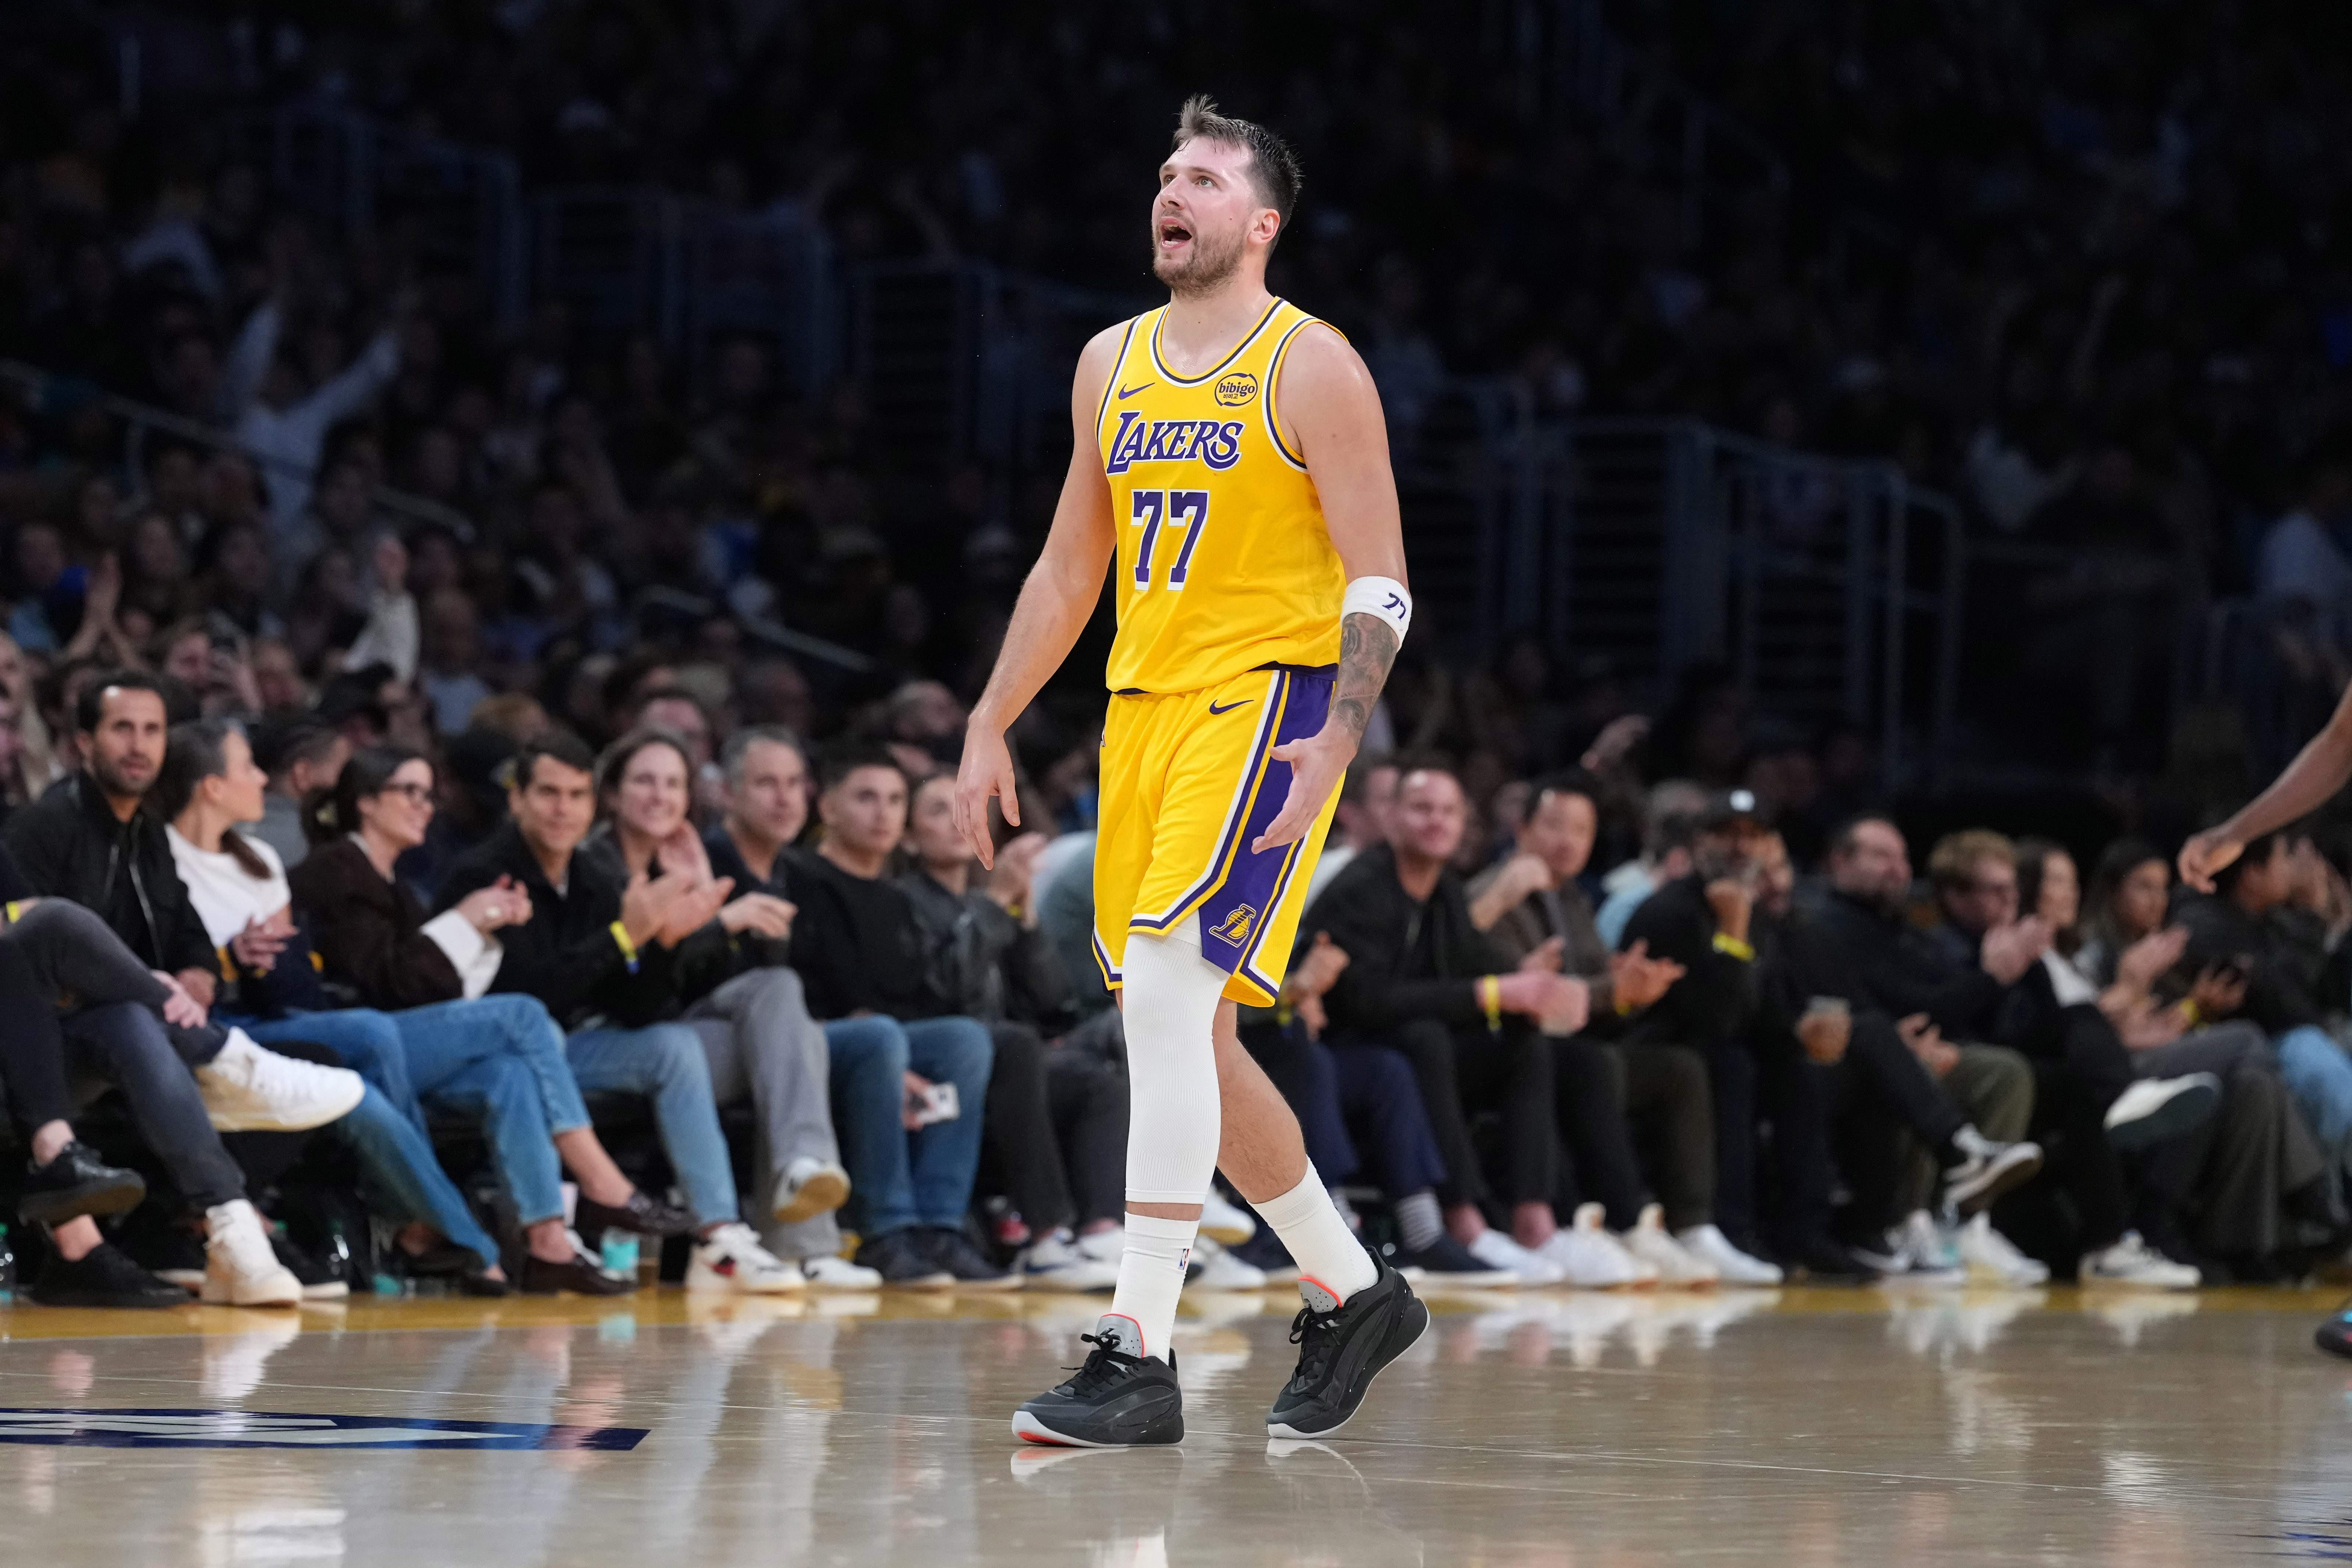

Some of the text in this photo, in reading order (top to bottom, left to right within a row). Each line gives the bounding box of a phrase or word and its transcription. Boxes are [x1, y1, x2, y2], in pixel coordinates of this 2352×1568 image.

[1219, 382, 1255, 397] bibigo
[1106, 410, 1246, 475] LAKERS
[1131, 489, 1209, 591] 77
[1382, 592, 1406, 622] 77
